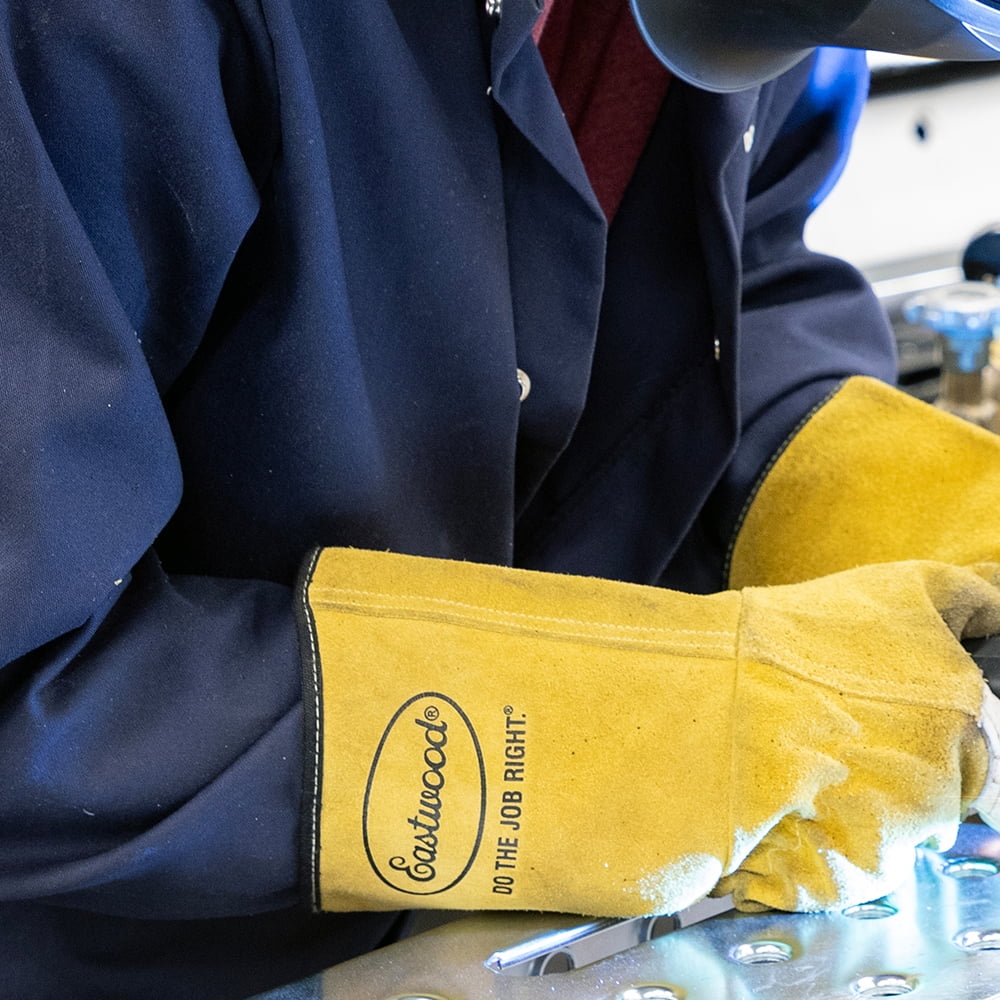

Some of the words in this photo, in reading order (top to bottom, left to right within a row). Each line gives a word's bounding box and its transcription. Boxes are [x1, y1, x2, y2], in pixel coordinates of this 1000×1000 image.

[500, 790, 523, 831] JOB
[495, 837, 518, 870] THE
[492, 875, 515, 895] DO
